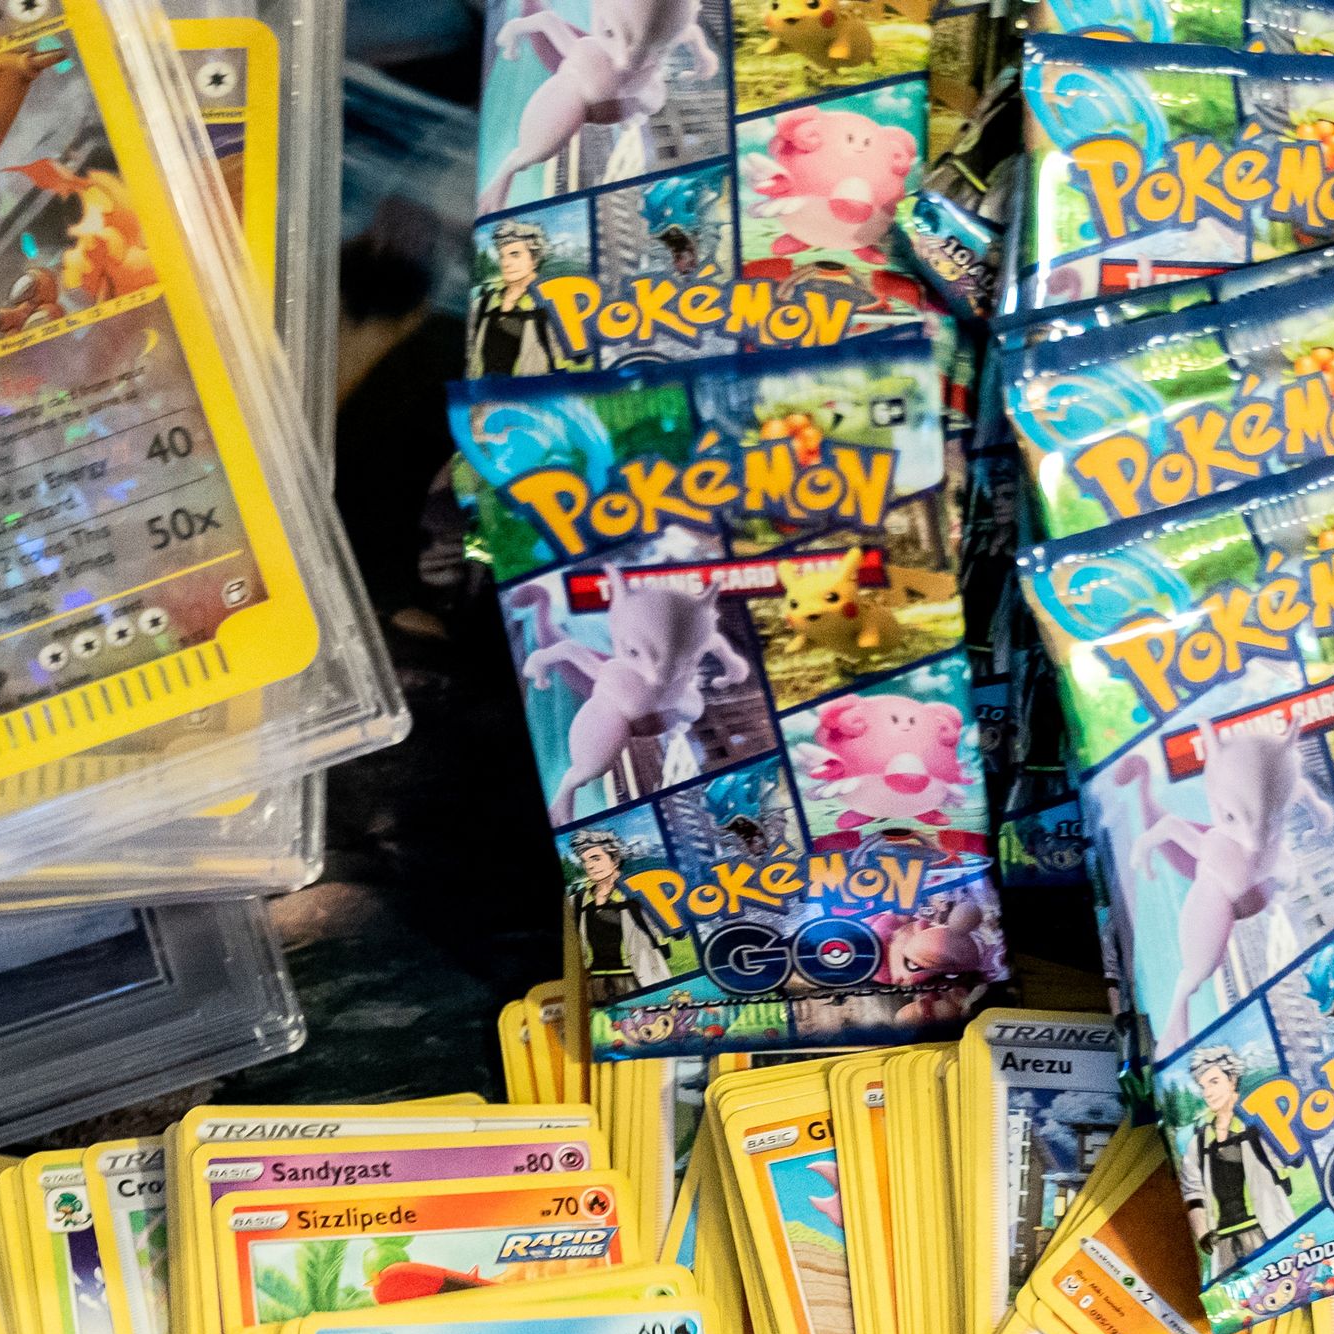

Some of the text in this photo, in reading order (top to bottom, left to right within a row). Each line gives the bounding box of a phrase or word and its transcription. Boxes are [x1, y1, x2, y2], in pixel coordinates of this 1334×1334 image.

[534, 264, 854, 355] Pokémon
[145, 427, 194, 464] 40
[508, 432, 896, 556] Pokémon
[625, 845, 923, 930] Pokémon
[703, 919, 881, 994] GO
[1000, 1051, 1073, 1074] Arezu
[205, 1122, 341, 1140] TRAINER
[746, 1130, 792, 1149] BASIC
[207, 1152, 554, 1187] BASIC Sandygast 80
[233, 1196, 580, 1236] BASIC Sizzlipede 70
[499, 1229, 609, 1259] RAPID
[549, 1242, 606, 1260] STRIKE
